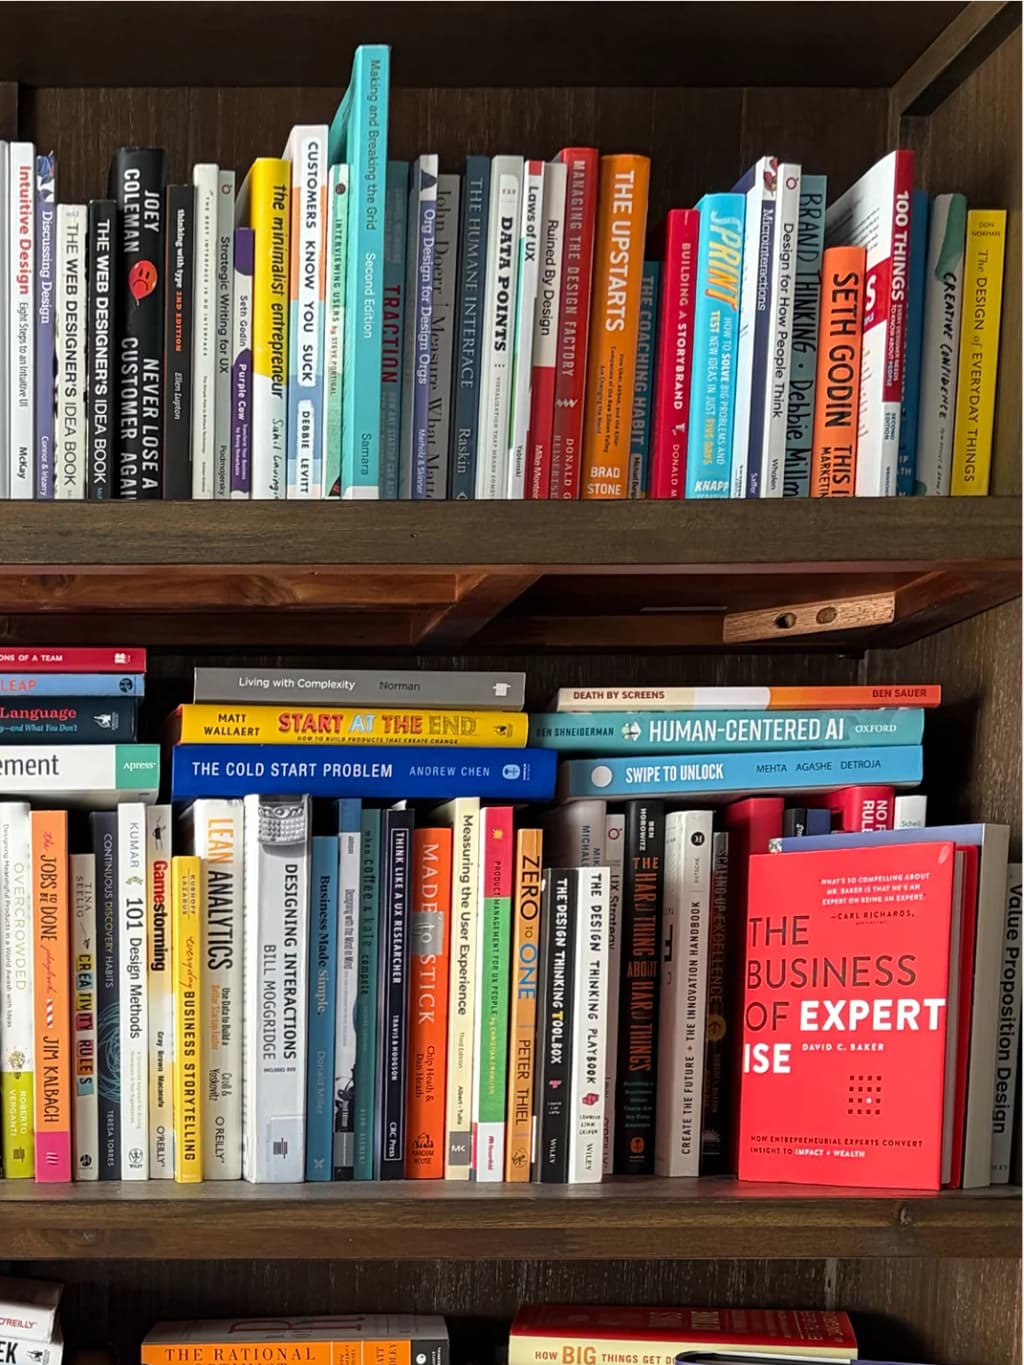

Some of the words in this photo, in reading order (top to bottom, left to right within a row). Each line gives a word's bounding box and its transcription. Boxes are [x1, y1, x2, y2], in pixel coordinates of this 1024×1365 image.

[19, 165, 32, 233] Intuitive
[306, 142, 319, 229] CUSTOMERS
[614, 171, 634, 214] THE
[499, 216, 513, 269] DATA
[19, 237, 30, 295] Design
[305, 237, 316, 290] KNOW
[604, 221, 631, 332] UPSTARTS
[303, 300, 315, 335] YOU
[494, 275, 510, 352] POINTS
[832, 272, 858, 338] SETH
[301, 345, 313, 383] SUCK
[825, 345, 856, 428] GODIN
[239, 678, 269, 689] Living
[273, 678, 294, 689] with
[297, 679, 356, 691] Complexity
[379, 680, 420, 692] Norman
[0, 706, 77, 721] Language
[649, 719, 820, 743] HUMAN-CENTERED
[824, 718, 844, 740] AI
[855, 724, 897, 733] OXFORD
[192, 762, 219, 776] THE
[225, 762, 264, 777] COLD
[271, 763, 317, 777] START
[323, 763, 393, 778] PROBLEM
[409, 766, 455, 777] ANDREW
[461, 767, 490, 777] CHEN
[625, 766, 659, 784] SWIPE
[663, 766, 677, 782] TO
[680, 763, 724, 781] UNLOCK
[207, 817, 233, 865] LEAN
[207, 870, 232, 971] ANALYTICS
[749, 915, 810, 946] THE
[748, 954, 916, 989] BUSINESS
[746, 1001, 788, 1033] OF
[800, 998, 946, 1032] EXPERT
[42, 1036, 60, 1060] JIM
[515, 1040, 530, 1081] PETER
[744, 1043, 791, 1074] ISE
[802, 1043, 832, 1052] DAVID
[838, 1043, 846, 1051] C.
[851, 1043, 884, 1051] BAKER
[43, 1066, 60, 1122] KALBACH
[513, 1088, 529, 1126] THIEL
[166, 1349, 208, 1361] THE
[214, 1348, 316, 1360] RATIONAL
